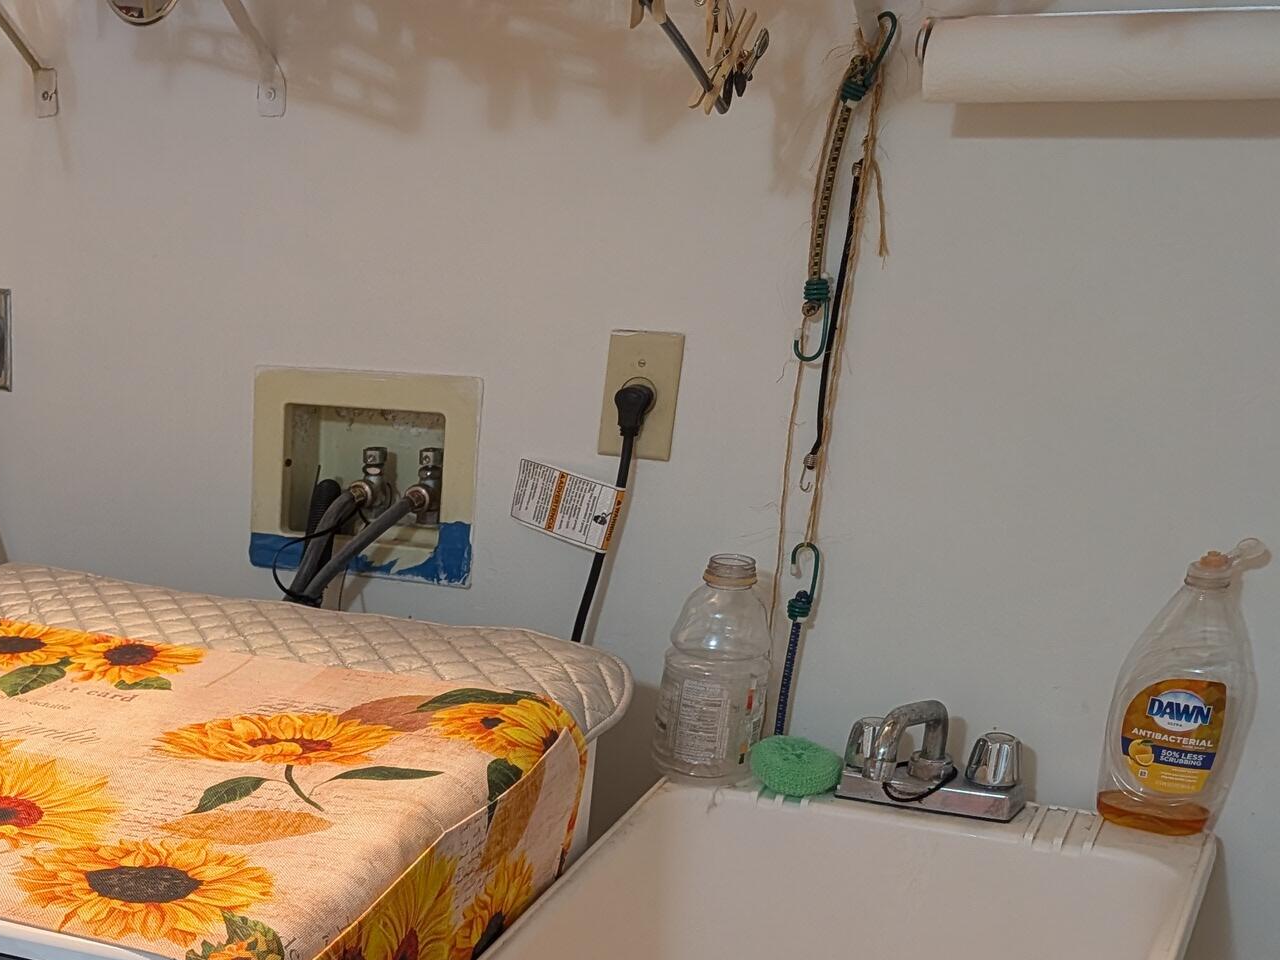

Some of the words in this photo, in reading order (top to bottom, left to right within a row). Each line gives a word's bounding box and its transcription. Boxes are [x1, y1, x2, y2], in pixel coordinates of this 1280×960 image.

[605, 506, 620, 542] WARNING
[1147, 697, 1212, 725] DAWN
[1131, 727, 1214, 748] ANTIBACTERIAL
[1159, 756, 1202, 767] SCRUBBING
[1161, 750, 1180, 758] 50%
